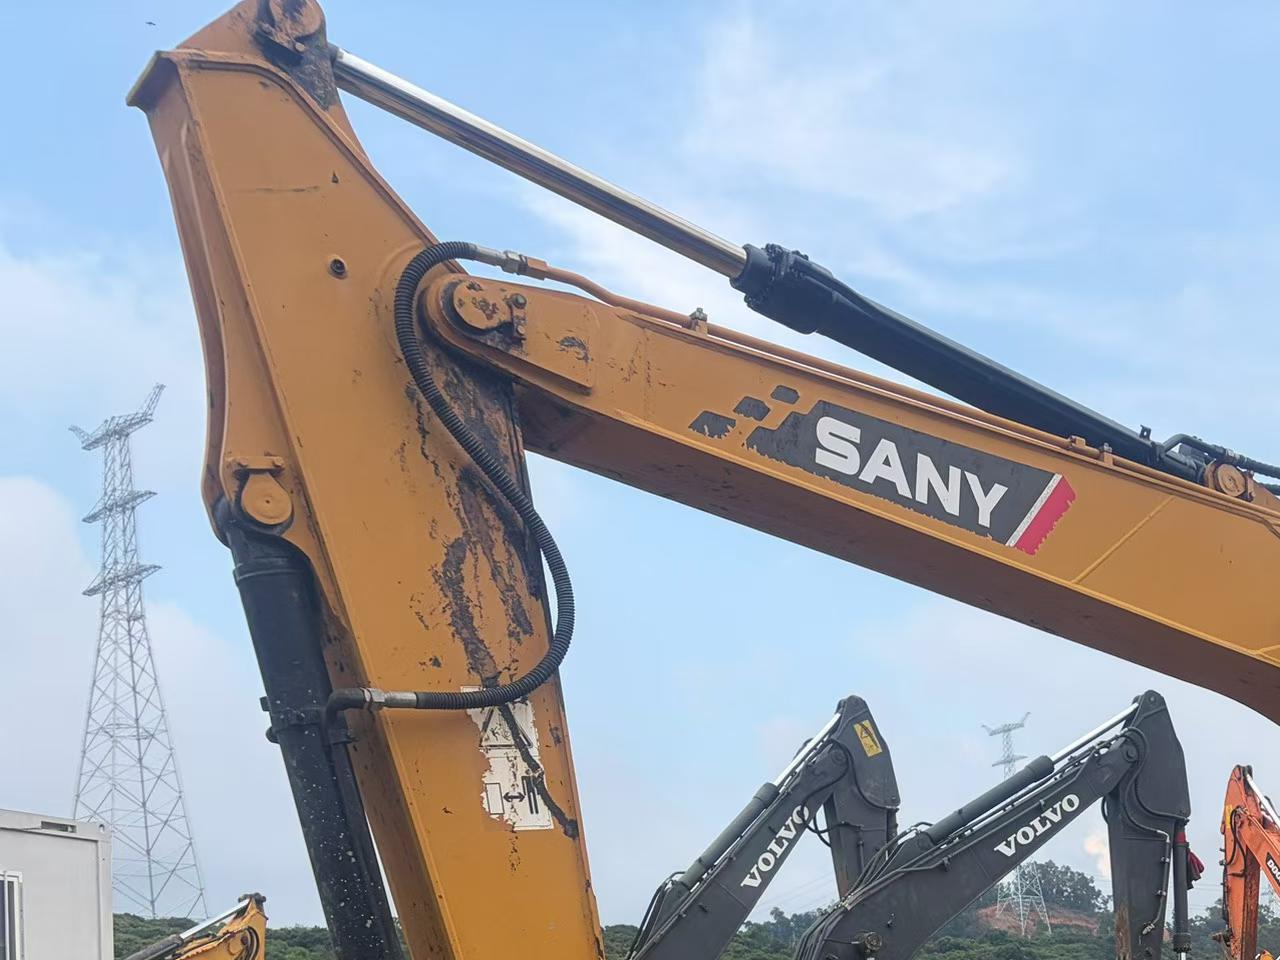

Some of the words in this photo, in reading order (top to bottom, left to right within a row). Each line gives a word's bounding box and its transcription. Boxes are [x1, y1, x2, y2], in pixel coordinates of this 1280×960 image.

[815, 416, 1008, 529] SANY
[740, 805, 810, 888] VOLVO
[993, 794, 1080, 857] VOLVO
